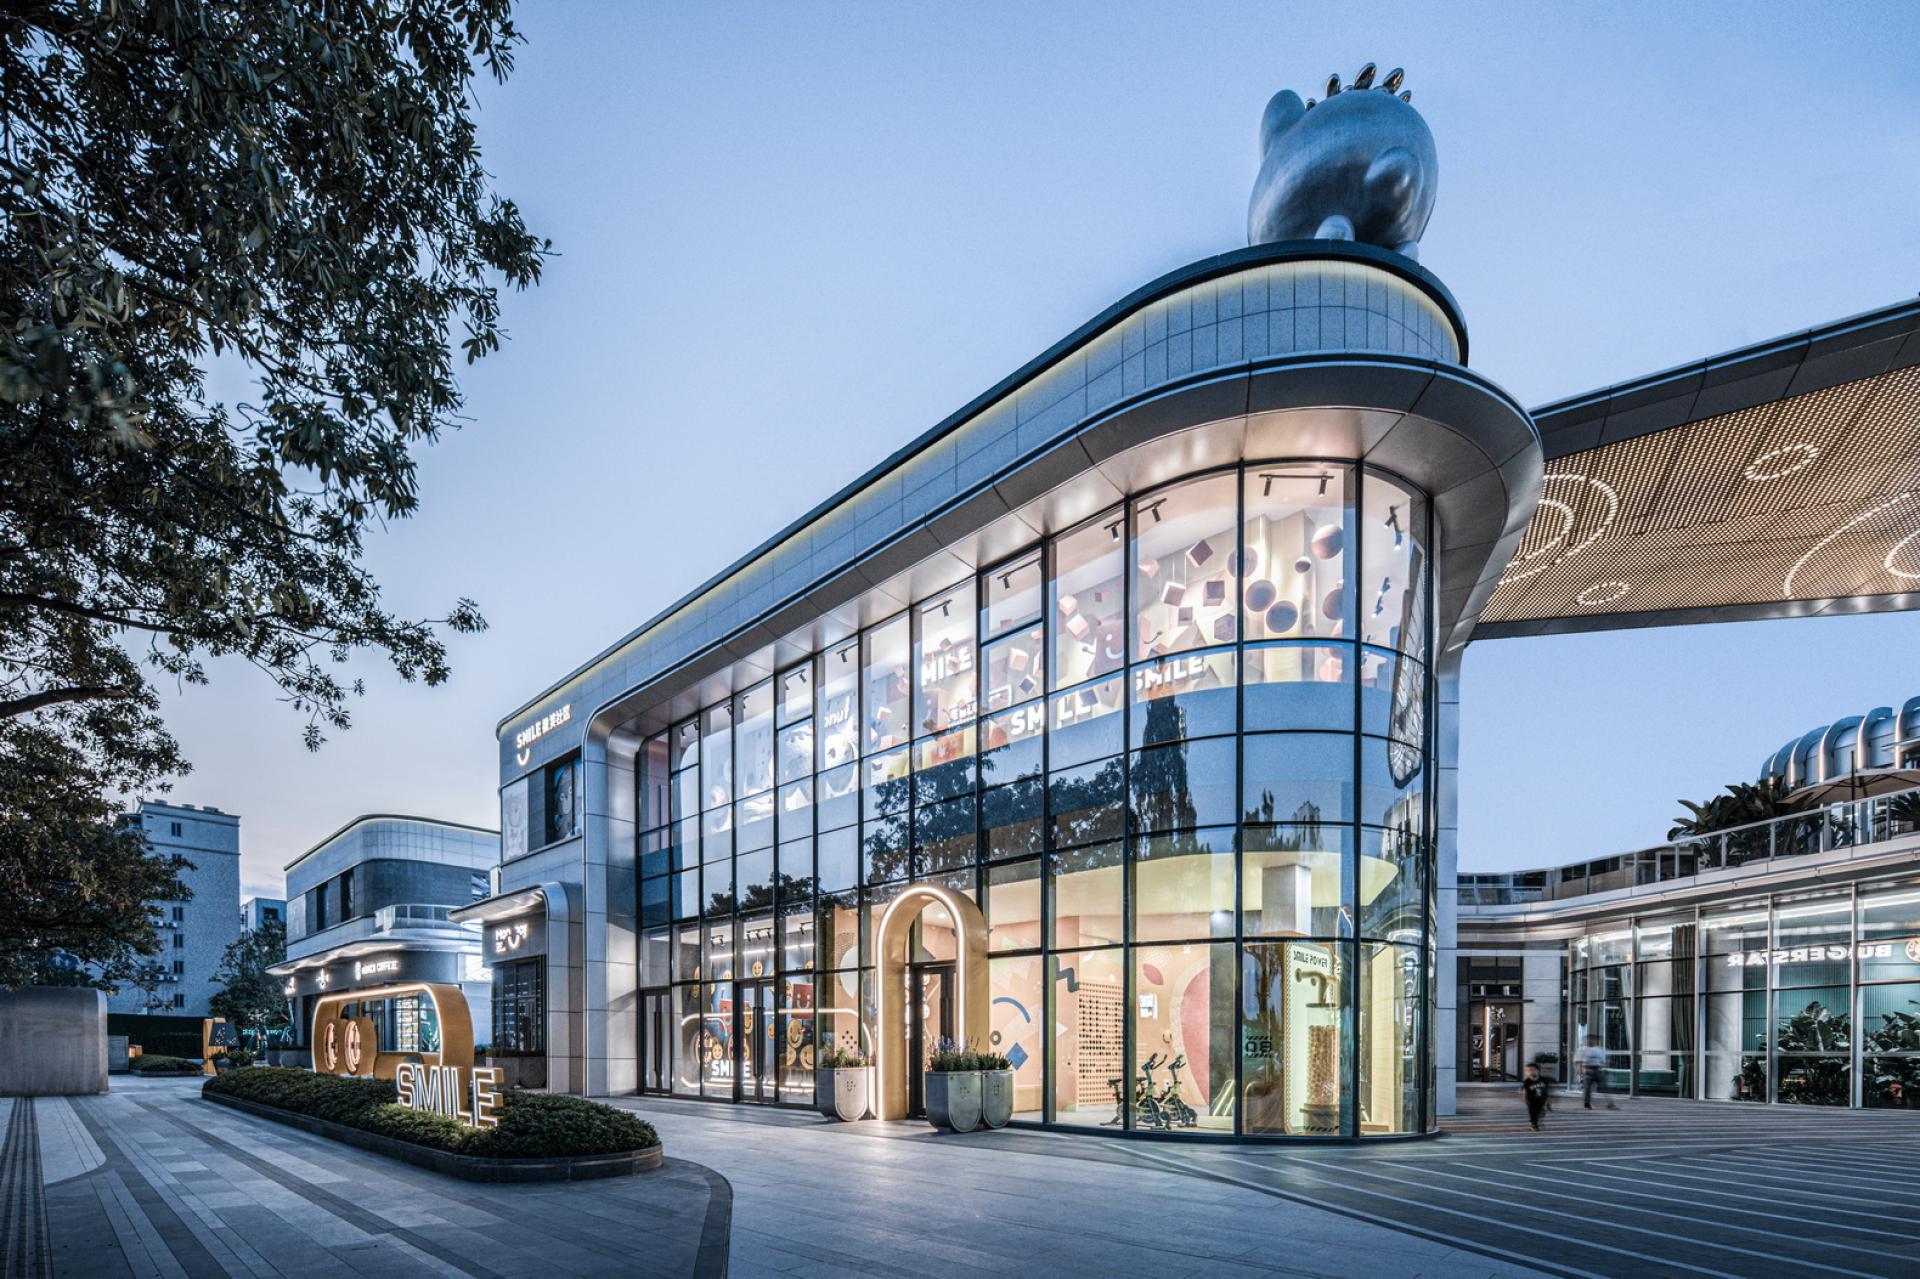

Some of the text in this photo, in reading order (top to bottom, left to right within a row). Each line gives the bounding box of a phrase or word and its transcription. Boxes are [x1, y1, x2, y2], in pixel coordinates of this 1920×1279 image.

[921, 646, 972, 687] MILE
[516, 721, 542, 749] SMILE
[711, 1060, 751, 1078] SMIE
[396, 1063, 503, 1129] SMILE
